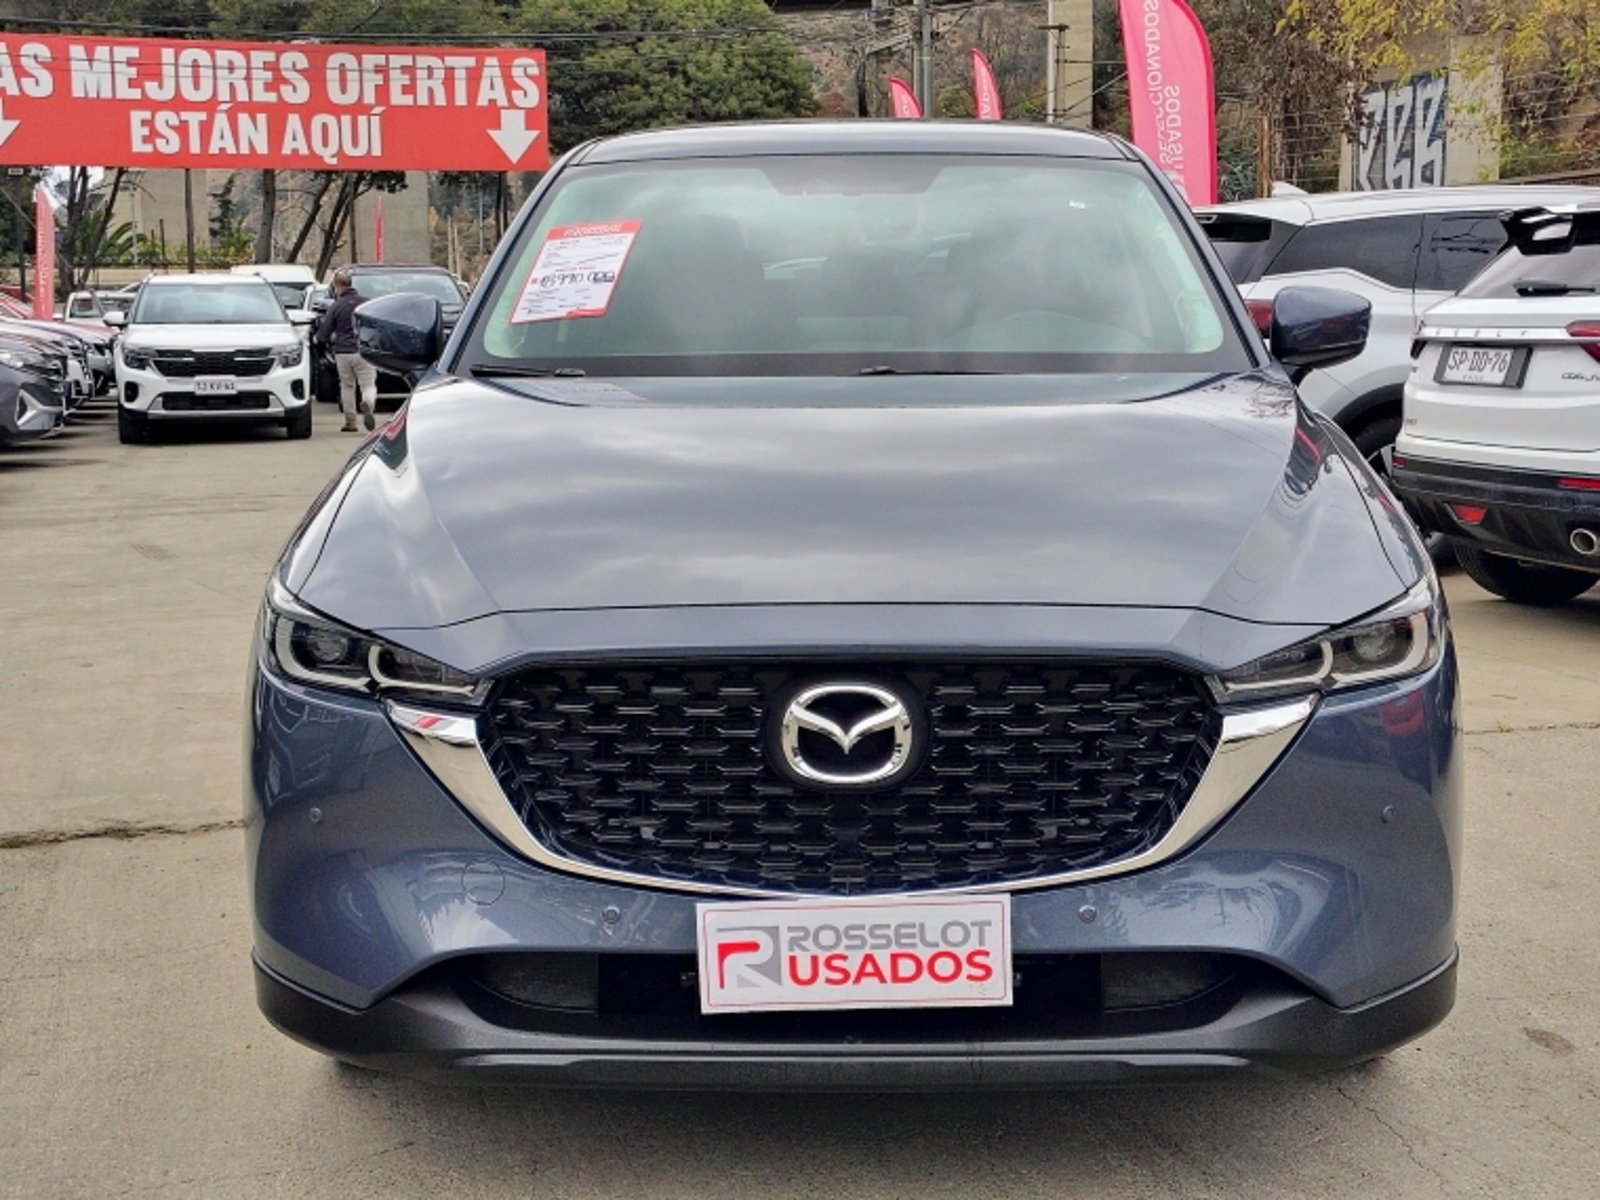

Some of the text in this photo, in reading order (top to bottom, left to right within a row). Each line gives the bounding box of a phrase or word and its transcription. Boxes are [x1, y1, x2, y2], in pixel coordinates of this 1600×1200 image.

[69, 44, 310, 104] MEJORES
[326, 52, 540, 108] OFERTAS
[129, 102, 386, 165] ESTÁN AQUÍ
[787, 920, 992, 952] ROSSELOT
[788, 949, 993, 987] USADOS
